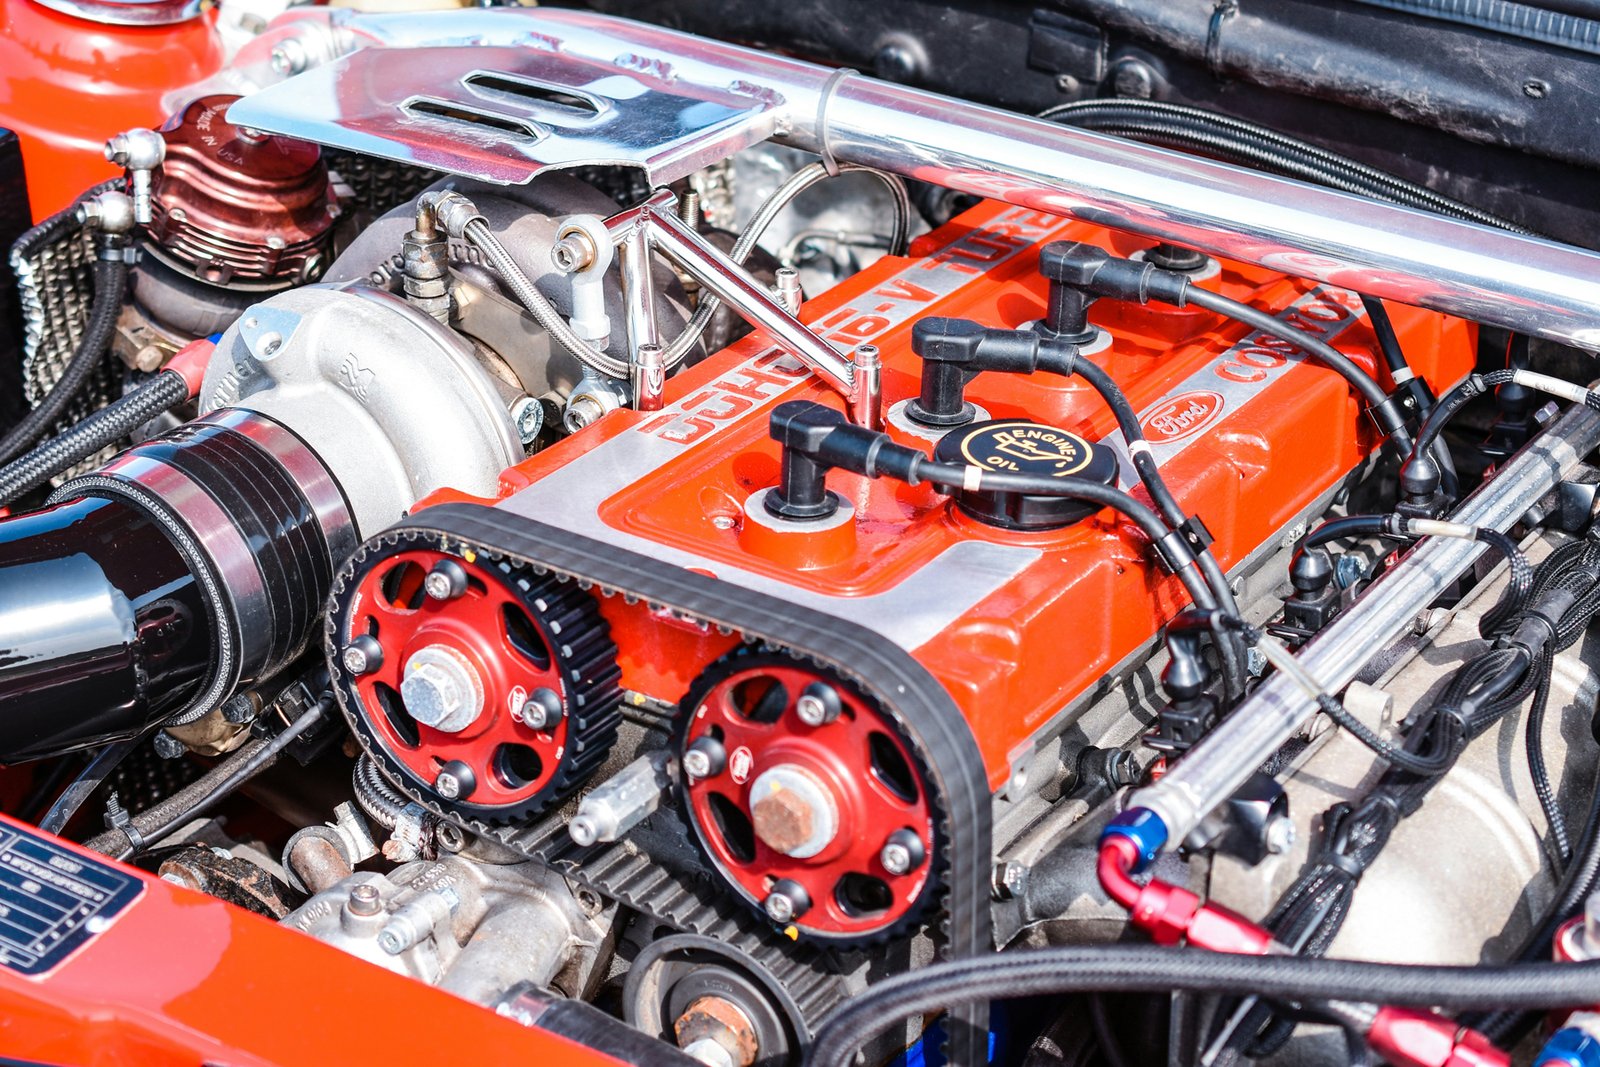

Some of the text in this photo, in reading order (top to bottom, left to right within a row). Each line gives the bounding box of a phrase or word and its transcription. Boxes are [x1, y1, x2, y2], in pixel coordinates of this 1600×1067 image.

[201, 135, 217, 147] IN
[217, 148, 244, 167] USA
[1150, 400, 1210, 436] Ford
[1012, 429, 1077, 456] ENGINE
[986, 456, 1020, 471] OIL
